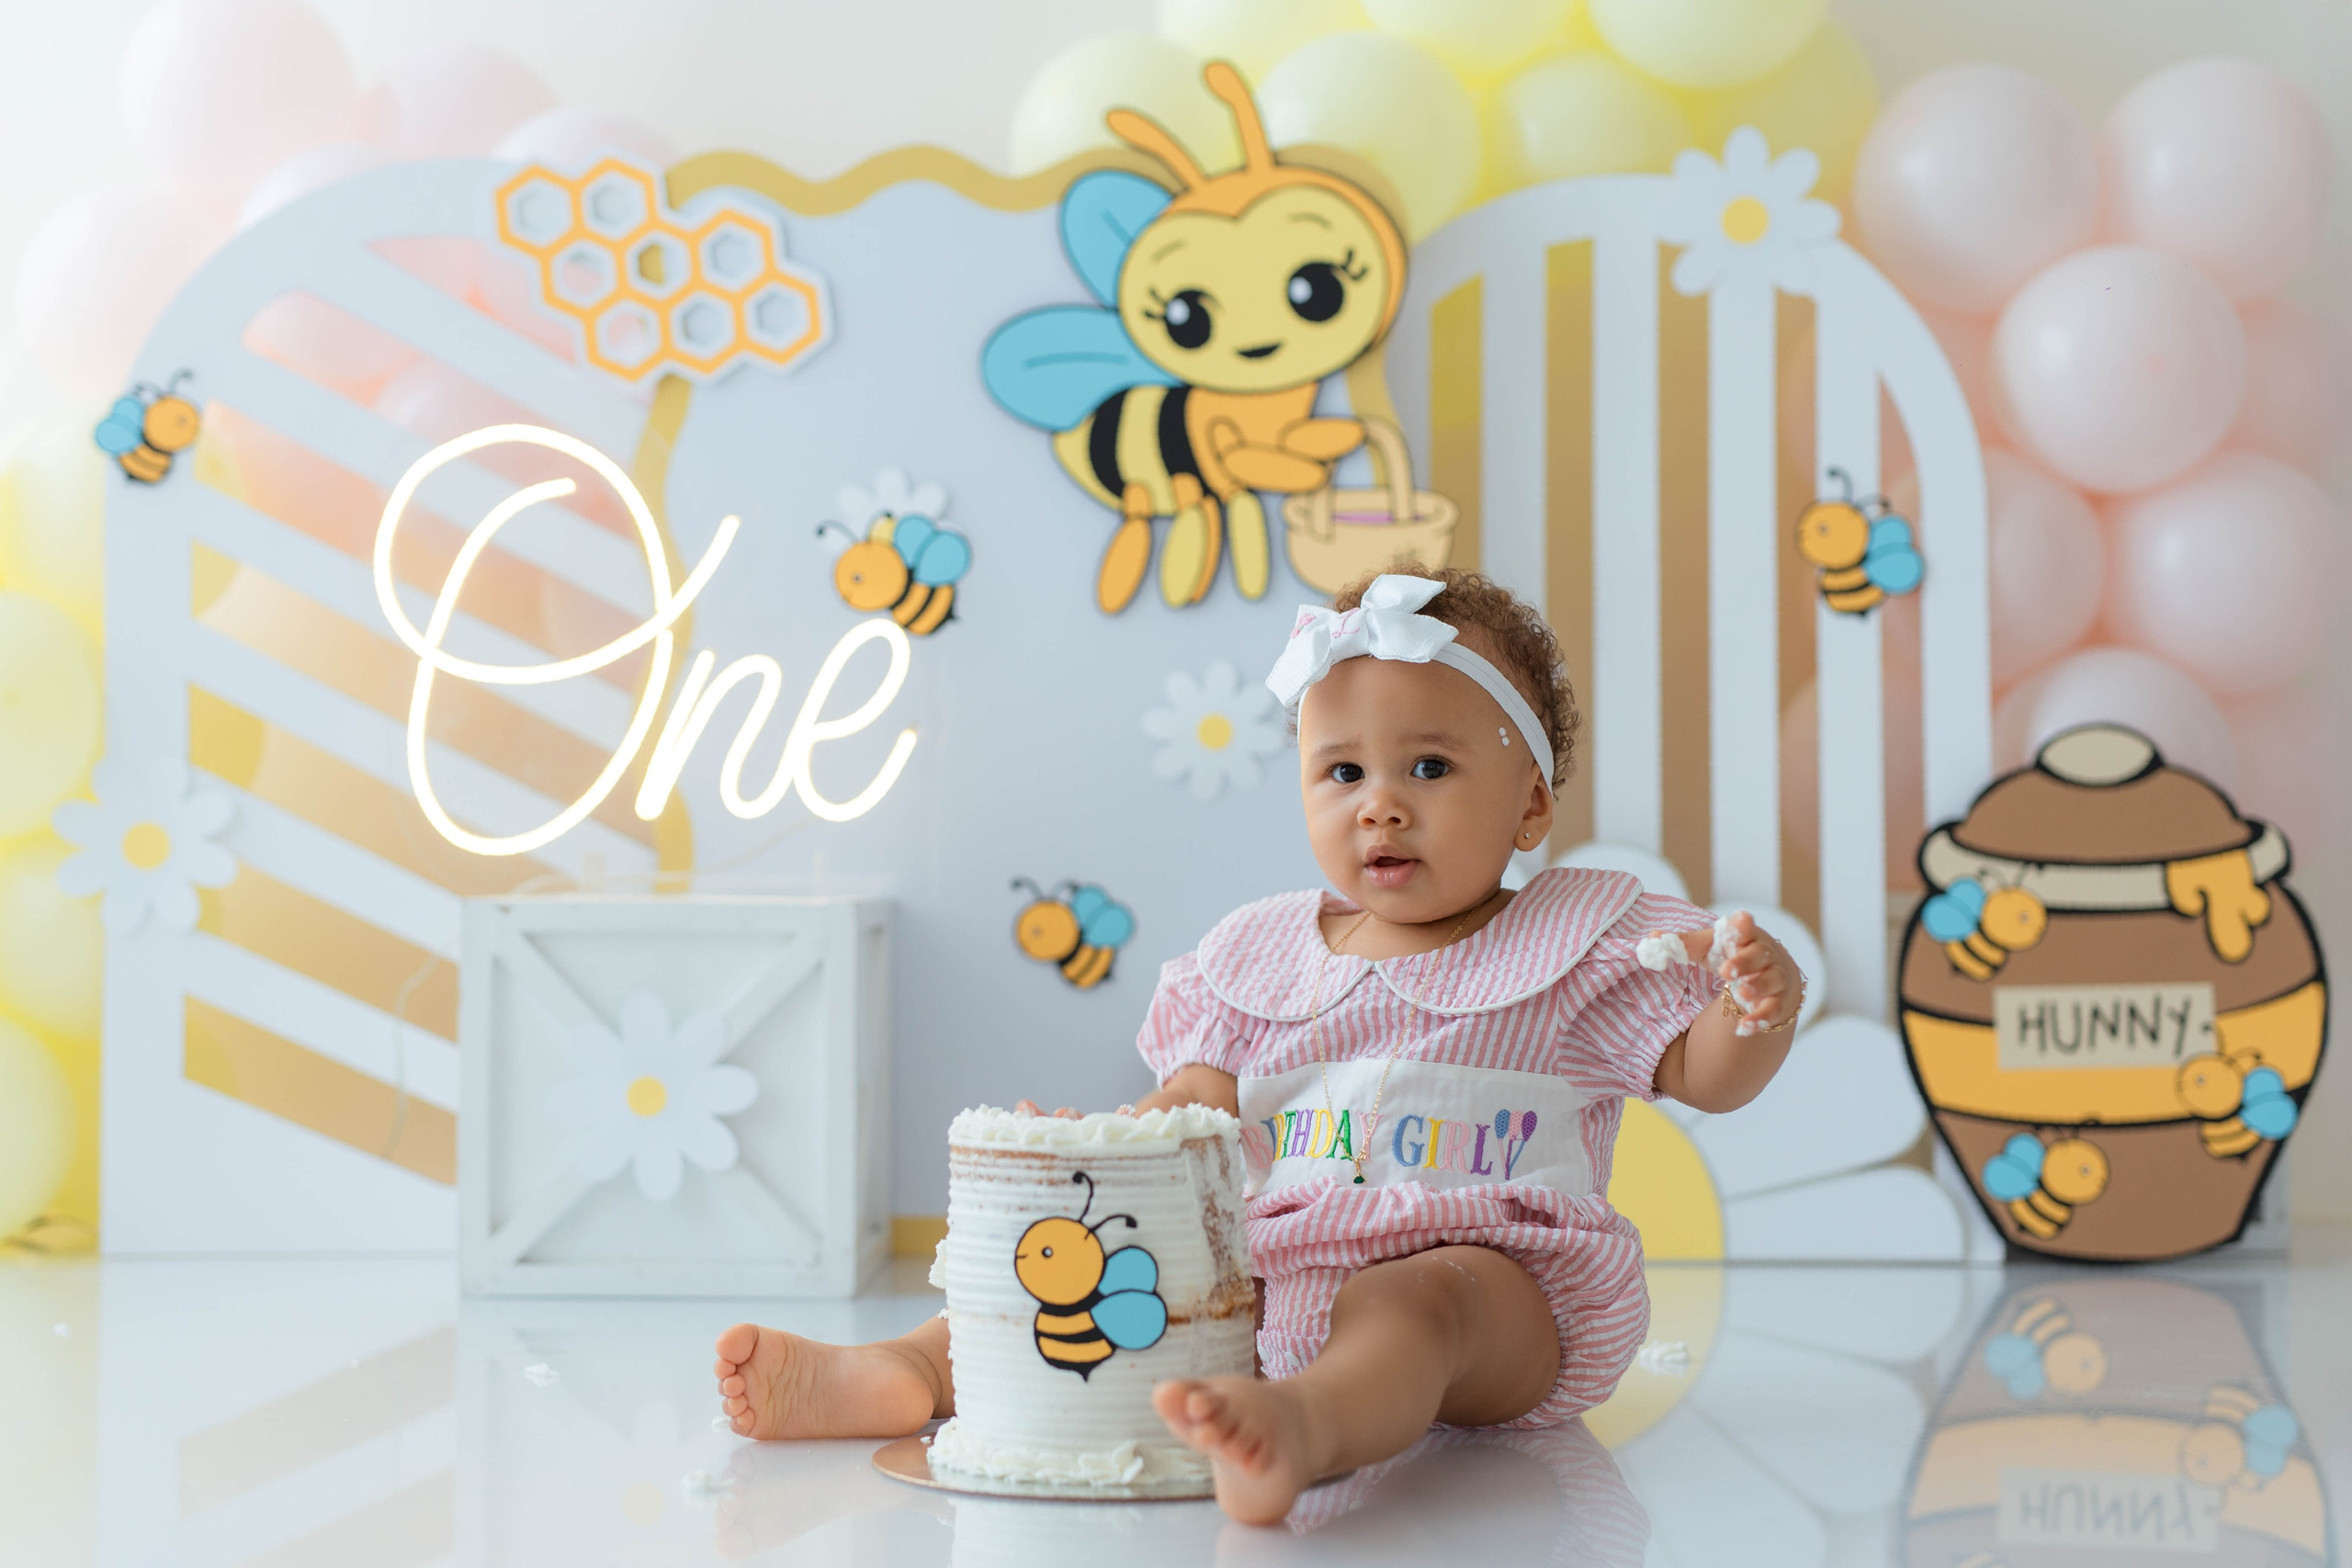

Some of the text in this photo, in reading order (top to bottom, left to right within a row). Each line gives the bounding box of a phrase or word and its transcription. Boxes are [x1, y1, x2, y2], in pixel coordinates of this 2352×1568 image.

[372, 423, 918, 856] One
[2018, 993, 2192, 1058] HUNNY
[1392, 1113, 1493, 1176] GIRL
